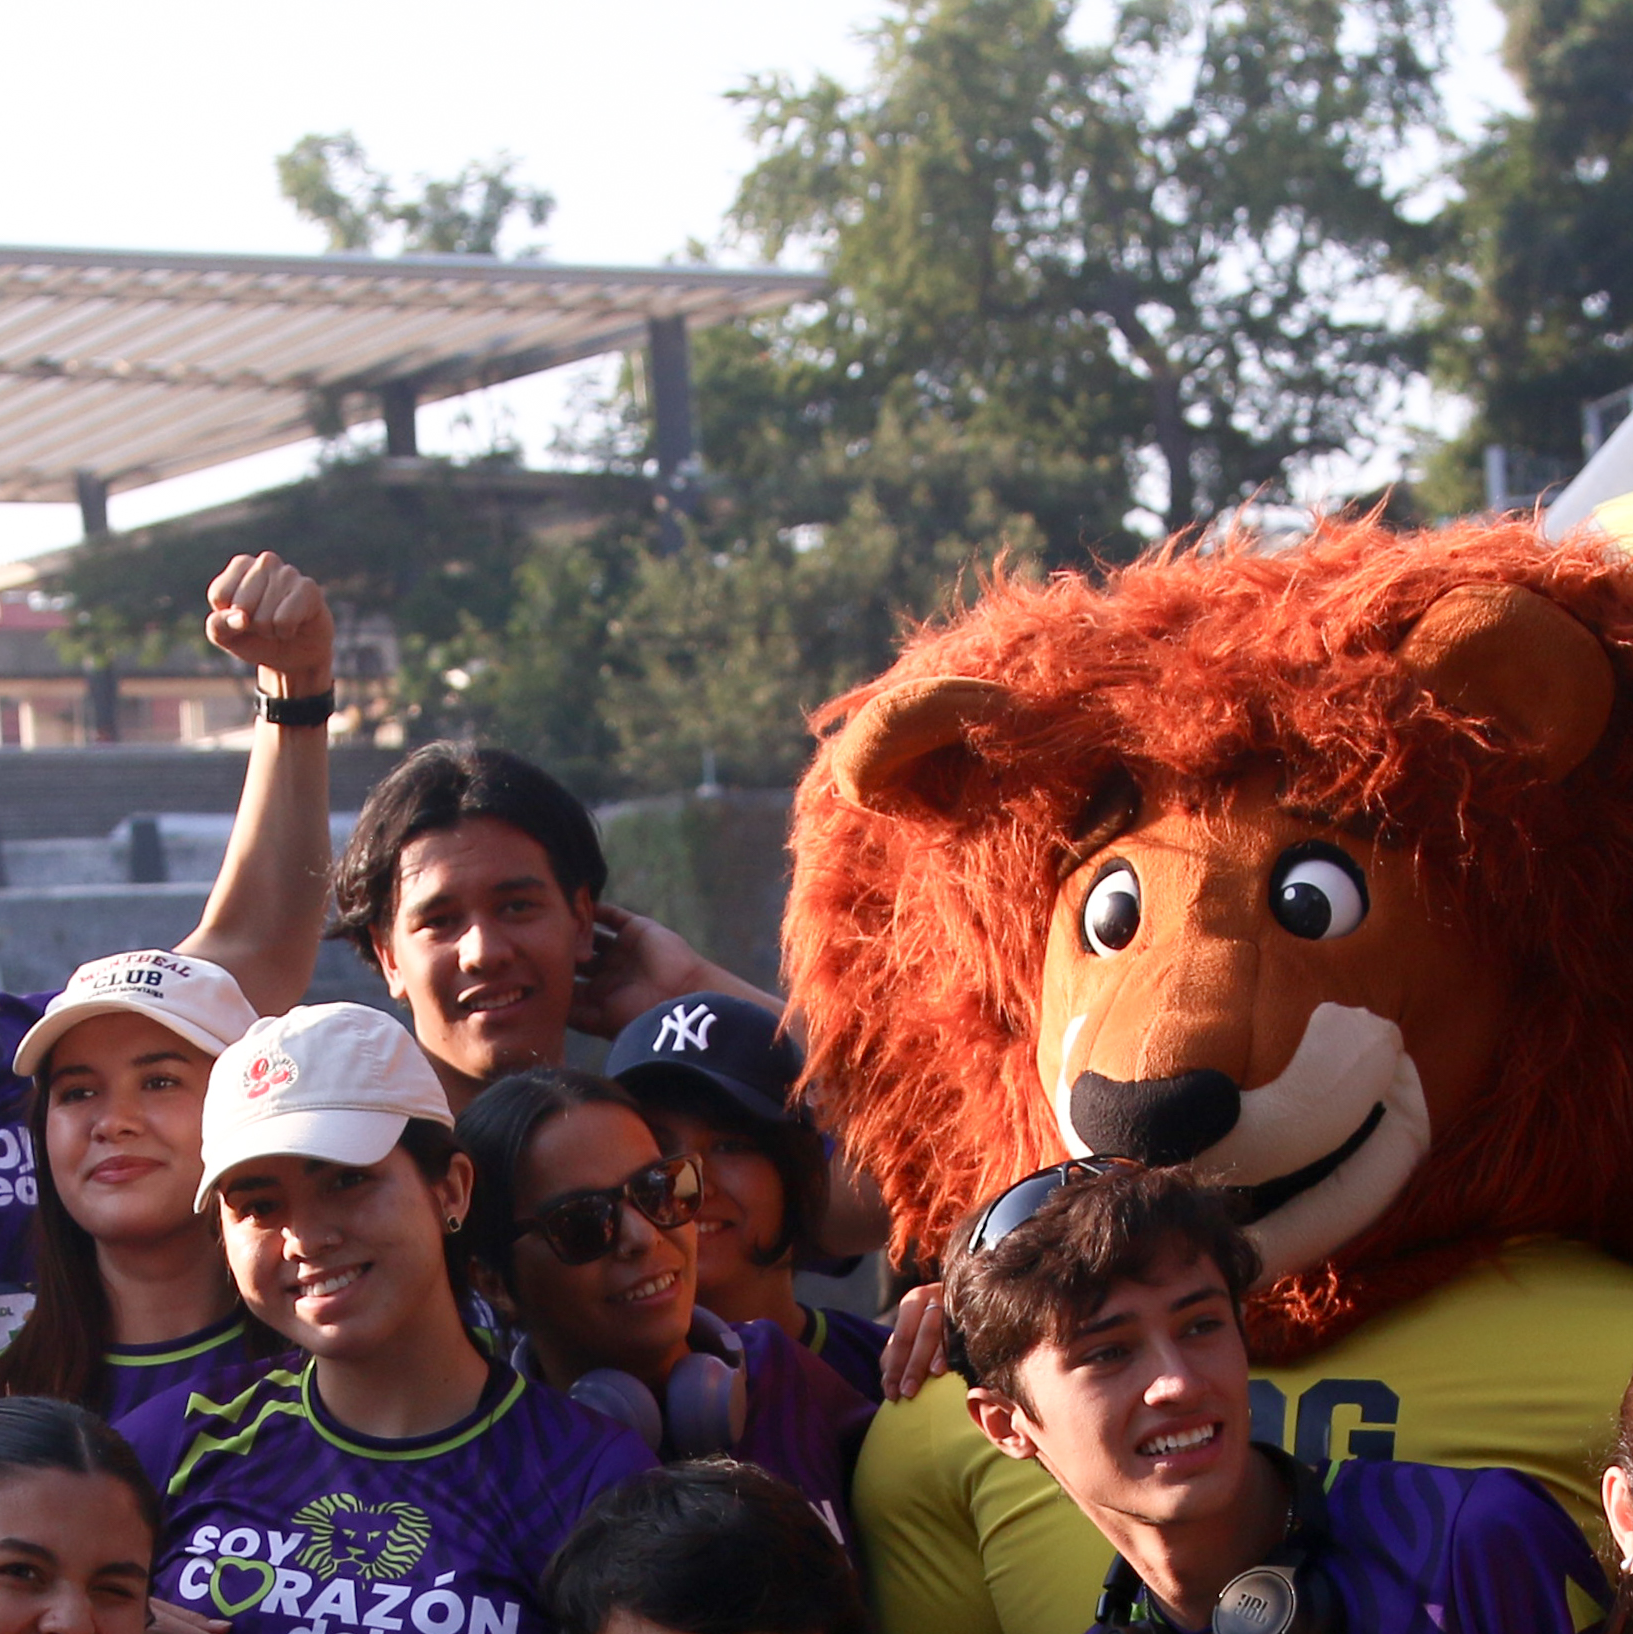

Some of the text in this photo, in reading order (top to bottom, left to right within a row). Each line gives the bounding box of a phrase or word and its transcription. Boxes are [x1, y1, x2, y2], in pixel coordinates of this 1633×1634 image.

[93, 969, 163, 989] CLUB
[653, 1003, 718, 1053] NY
[184, 1524, 305, 1561] SOY
[1234, 1593, 1269, 1626] JBL
